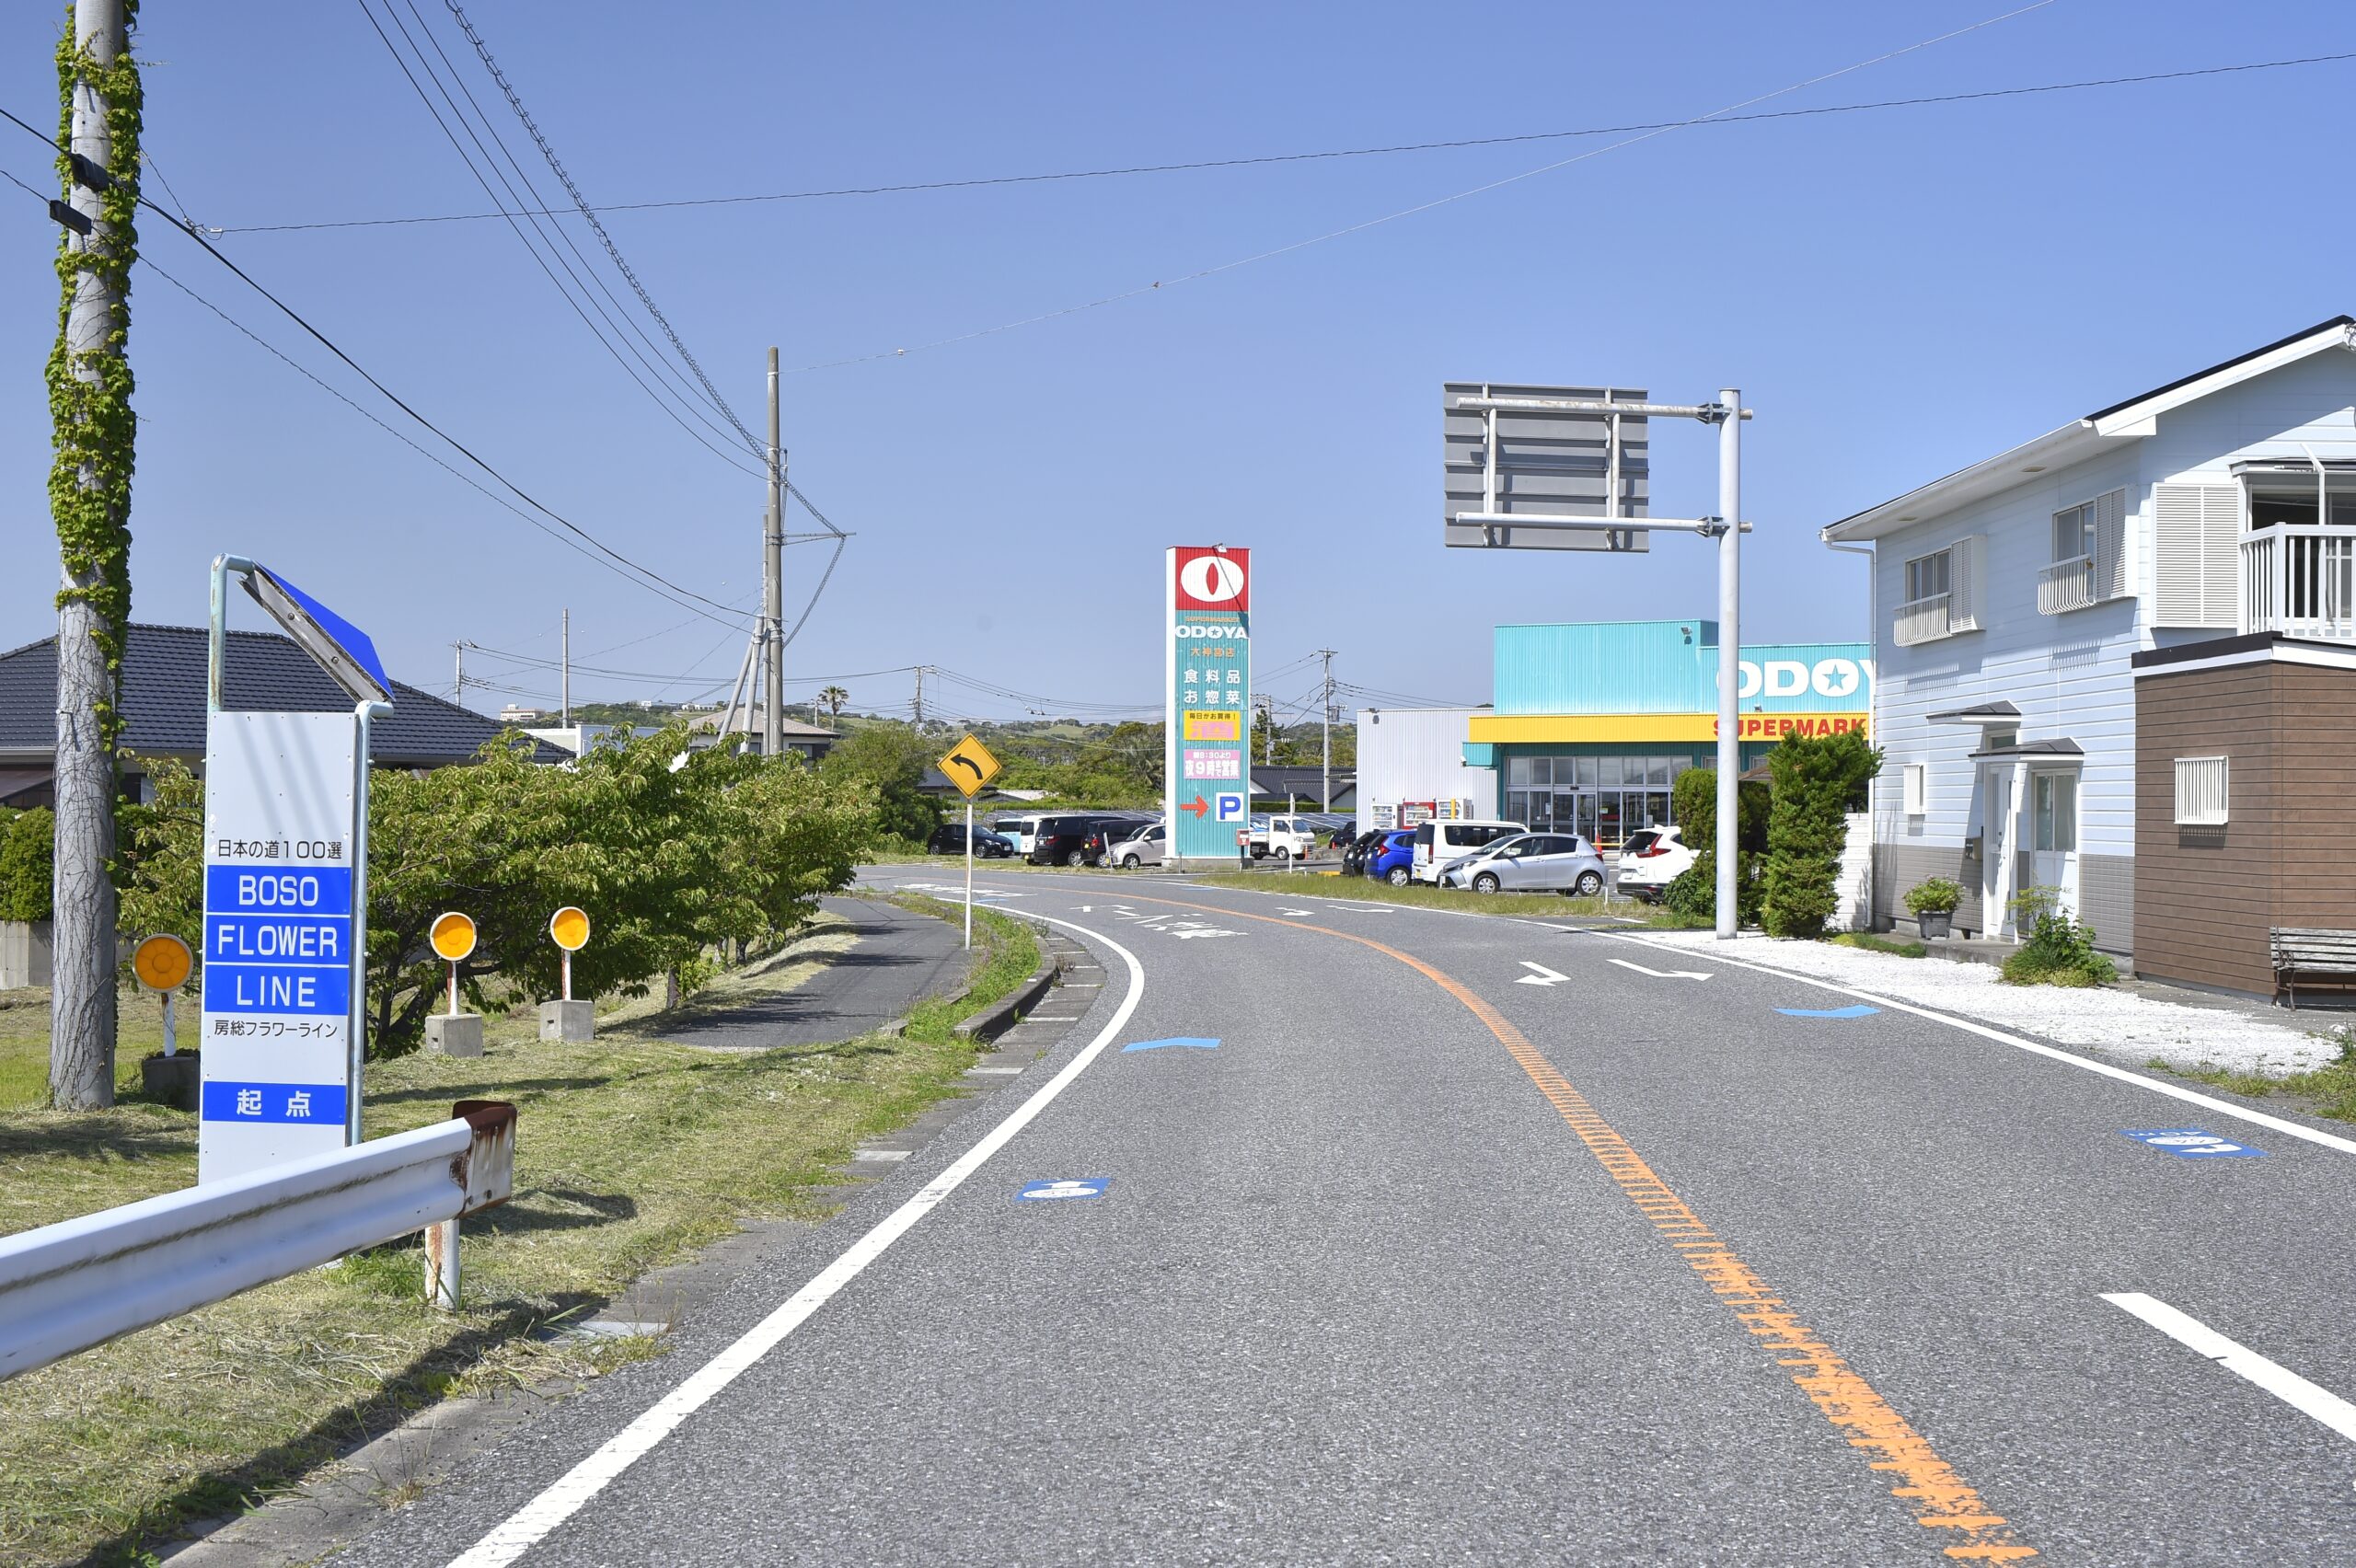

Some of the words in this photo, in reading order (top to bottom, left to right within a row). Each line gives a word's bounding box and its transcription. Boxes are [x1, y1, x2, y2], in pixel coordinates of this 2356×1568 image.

[1175, 625, 1248, 640] ODOYA
[1184, 669, 1241, 684] 食料品
[1184, 689, 1241, 705] お惣菜
[1219, 796, 1242, 820] P
[217, 838, 343, 859] 日本の道100選
[237, 874, 319, 906] BOSO
[217, 924, 338, 958] FLOWER
[236, 975, 317, 1008] LINE
[213, 1020, 339, 1039] 房総フラワーライン
[236, 1089, 313, 1118] 起点
